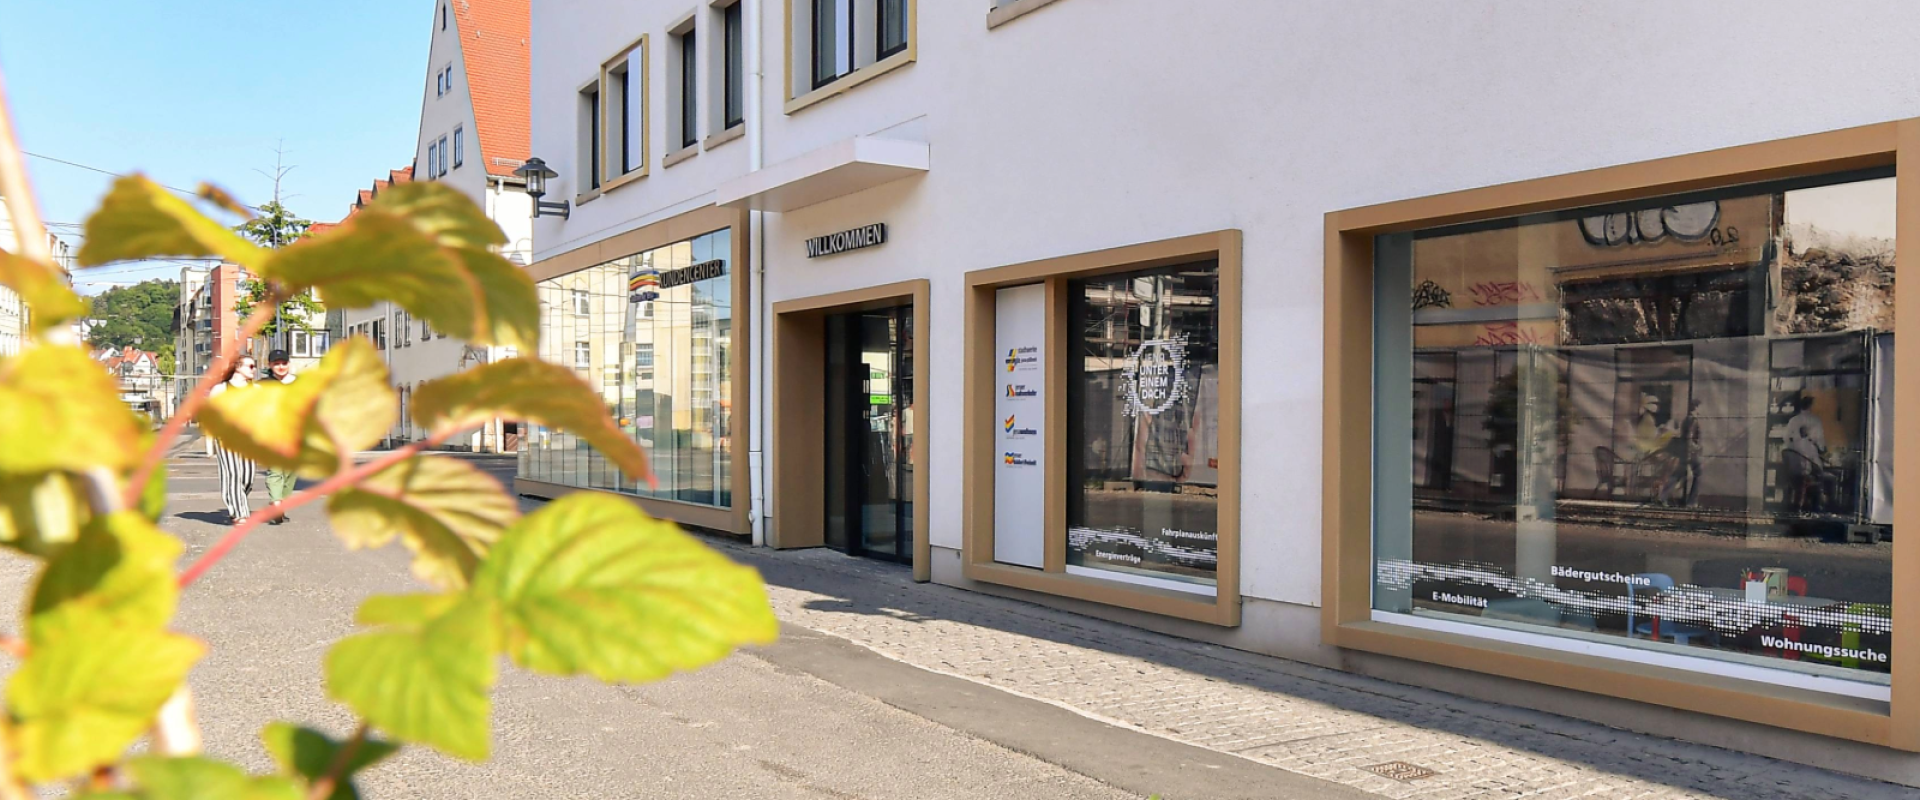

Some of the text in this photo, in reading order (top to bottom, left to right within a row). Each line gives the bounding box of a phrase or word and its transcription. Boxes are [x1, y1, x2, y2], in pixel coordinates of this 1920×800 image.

[805, 223, 886, 258] WILLKOMMEN
[659, 259, 724, 289] KUNDENCENTER
[1139, 364, 1169, 375] UNTER
[1139, 376, 1168, 387] EINEM
[1141, 388, 1166, 399] DACH
[1095, 549, 1142, 564] Energieverträge
[1550, 565, 1651, 587] Bädergutscheine
[1432, 591, 1489, 609] E-Mobilität
[1761, 634, 1888, 663] Wohnungssuche
